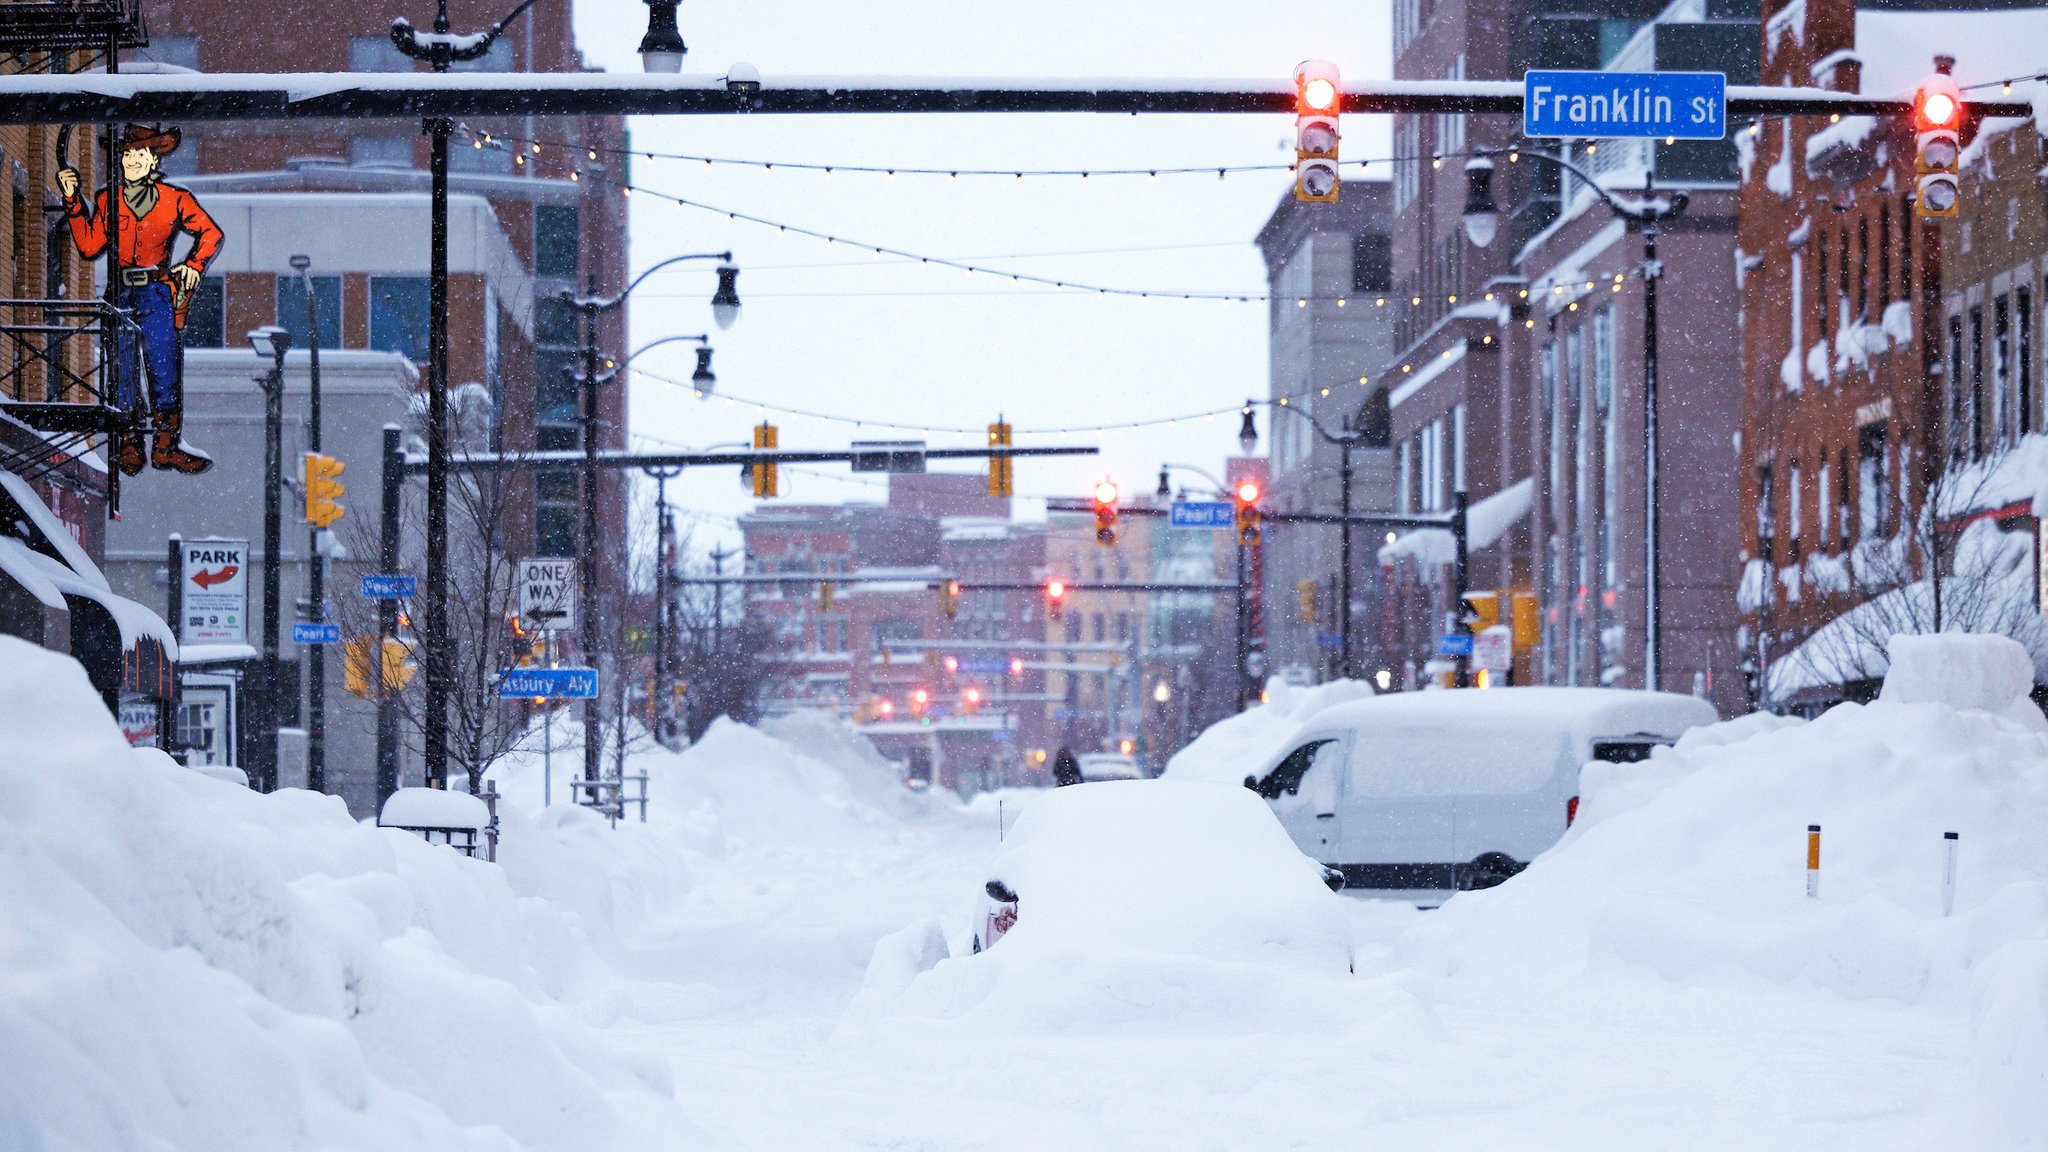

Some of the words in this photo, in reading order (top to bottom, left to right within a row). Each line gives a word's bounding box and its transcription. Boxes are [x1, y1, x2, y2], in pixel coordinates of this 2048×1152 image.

[1532, 86, 1672, 123] Franklin
[1690, 97, 1717, 124] St
[1175, 506, 1214, 522] Pearl
[190, 550, 240, 564] PARK
[528, 565, 566, 581] ONE
[528, 585, 567, 600] WAY
[295, 626, 324, 639] Pearl
[502, 676, 555, 694] Asbury
[568, 676, 593, 695] Aly
[121, 711, 156, 724] ARK
